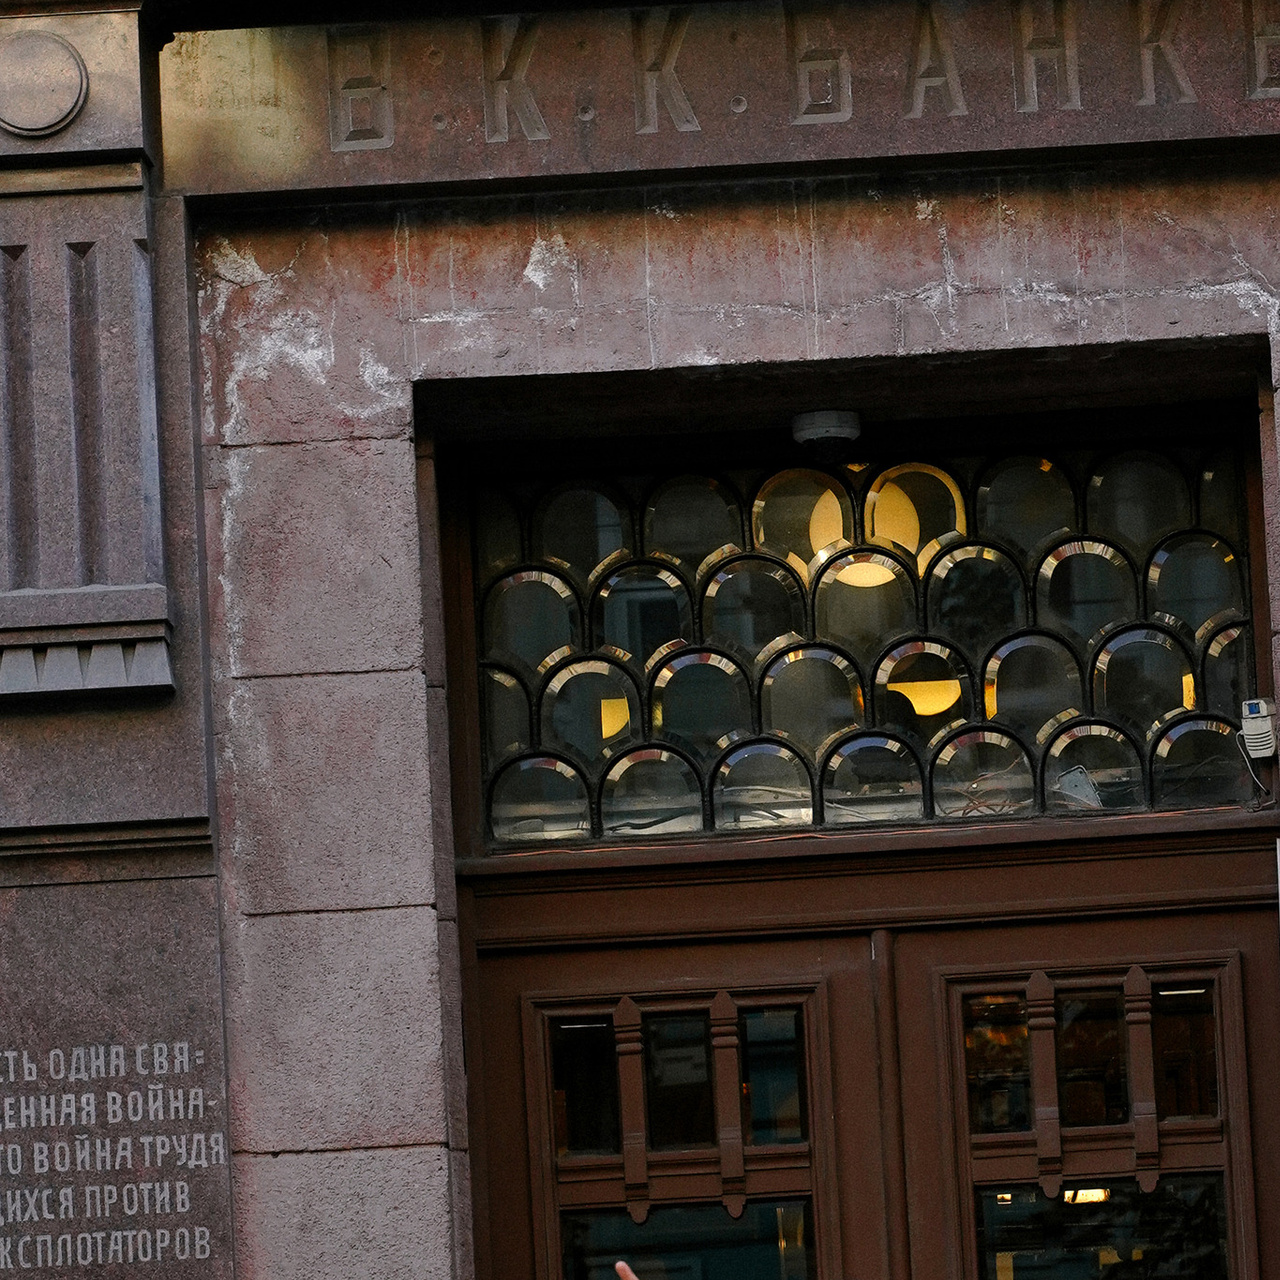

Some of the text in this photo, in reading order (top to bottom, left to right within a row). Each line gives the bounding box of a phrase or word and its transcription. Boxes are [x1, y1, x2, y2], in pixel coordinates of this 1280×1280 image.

[0, 1050, 37, 1083] ТЬ
[49, 1044, 126, 1082] ОДНА
[0, 1092, 96, 1132] ЕННАЯ
[33, 1134, 132, 1174] ВОЙНА
[139, 1131, 227, 1169] ТРУДЯ
[0, 1180, 190, 1226] ИХСЯ ПРОТИВ
